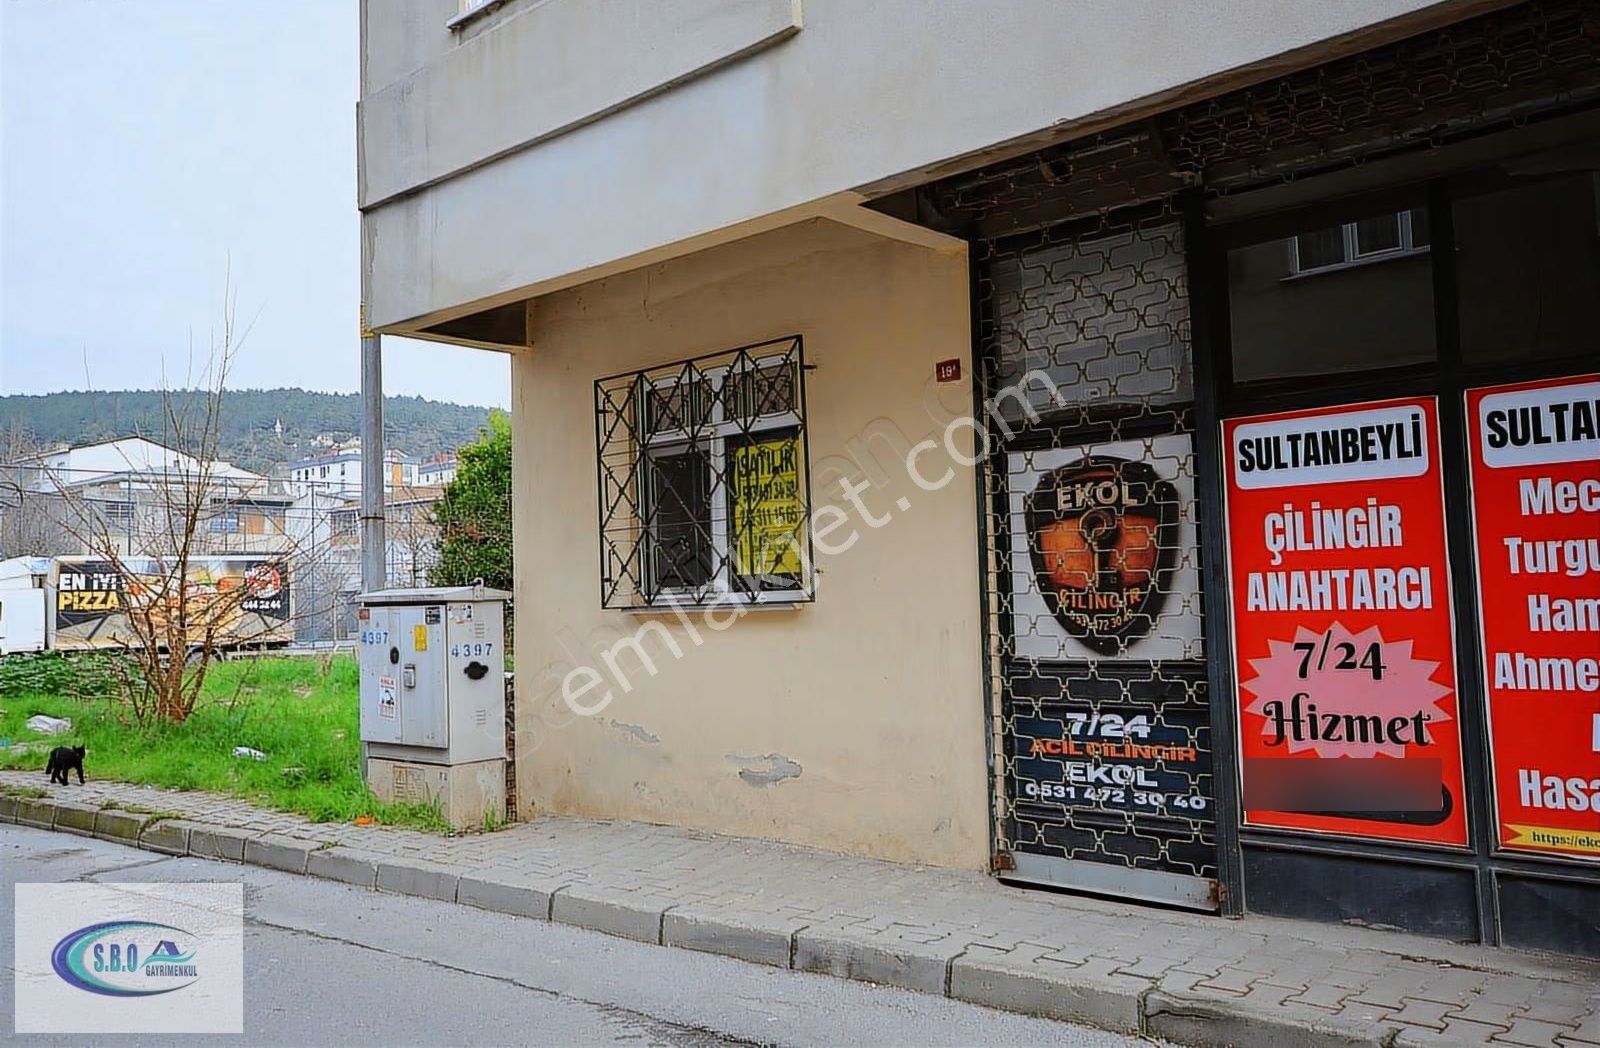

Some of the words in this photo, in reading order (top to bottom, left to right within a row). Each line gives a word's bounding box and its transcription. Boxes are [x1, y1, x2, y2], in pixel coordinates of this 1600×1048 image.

[1238, 413, 1423, 473] SULTANBEYLİ
[1486, 398, 1600, 449] SULTA
[1056, 480, 1138, 511] EKOL
[1519, 477, 1600, 516] Mec
[1264, 497, 1403, 566] ÇİLİNGİR
[59, 573, 86, 591] EN
[1247, 566, 1433, 612] ANAHTARCI
[361, 632, 388, 645] 4397
[451, 643, 493, 658] 4397
[1293, 629, 1388, 681] 7/24
[1494, 652, 1600, 692] Ahme
[1065, 712, 1151, 738] 7/24
[1262, 692, 1432, 747] Hizmet
[1066, 761, 1159, 787] EKOL
